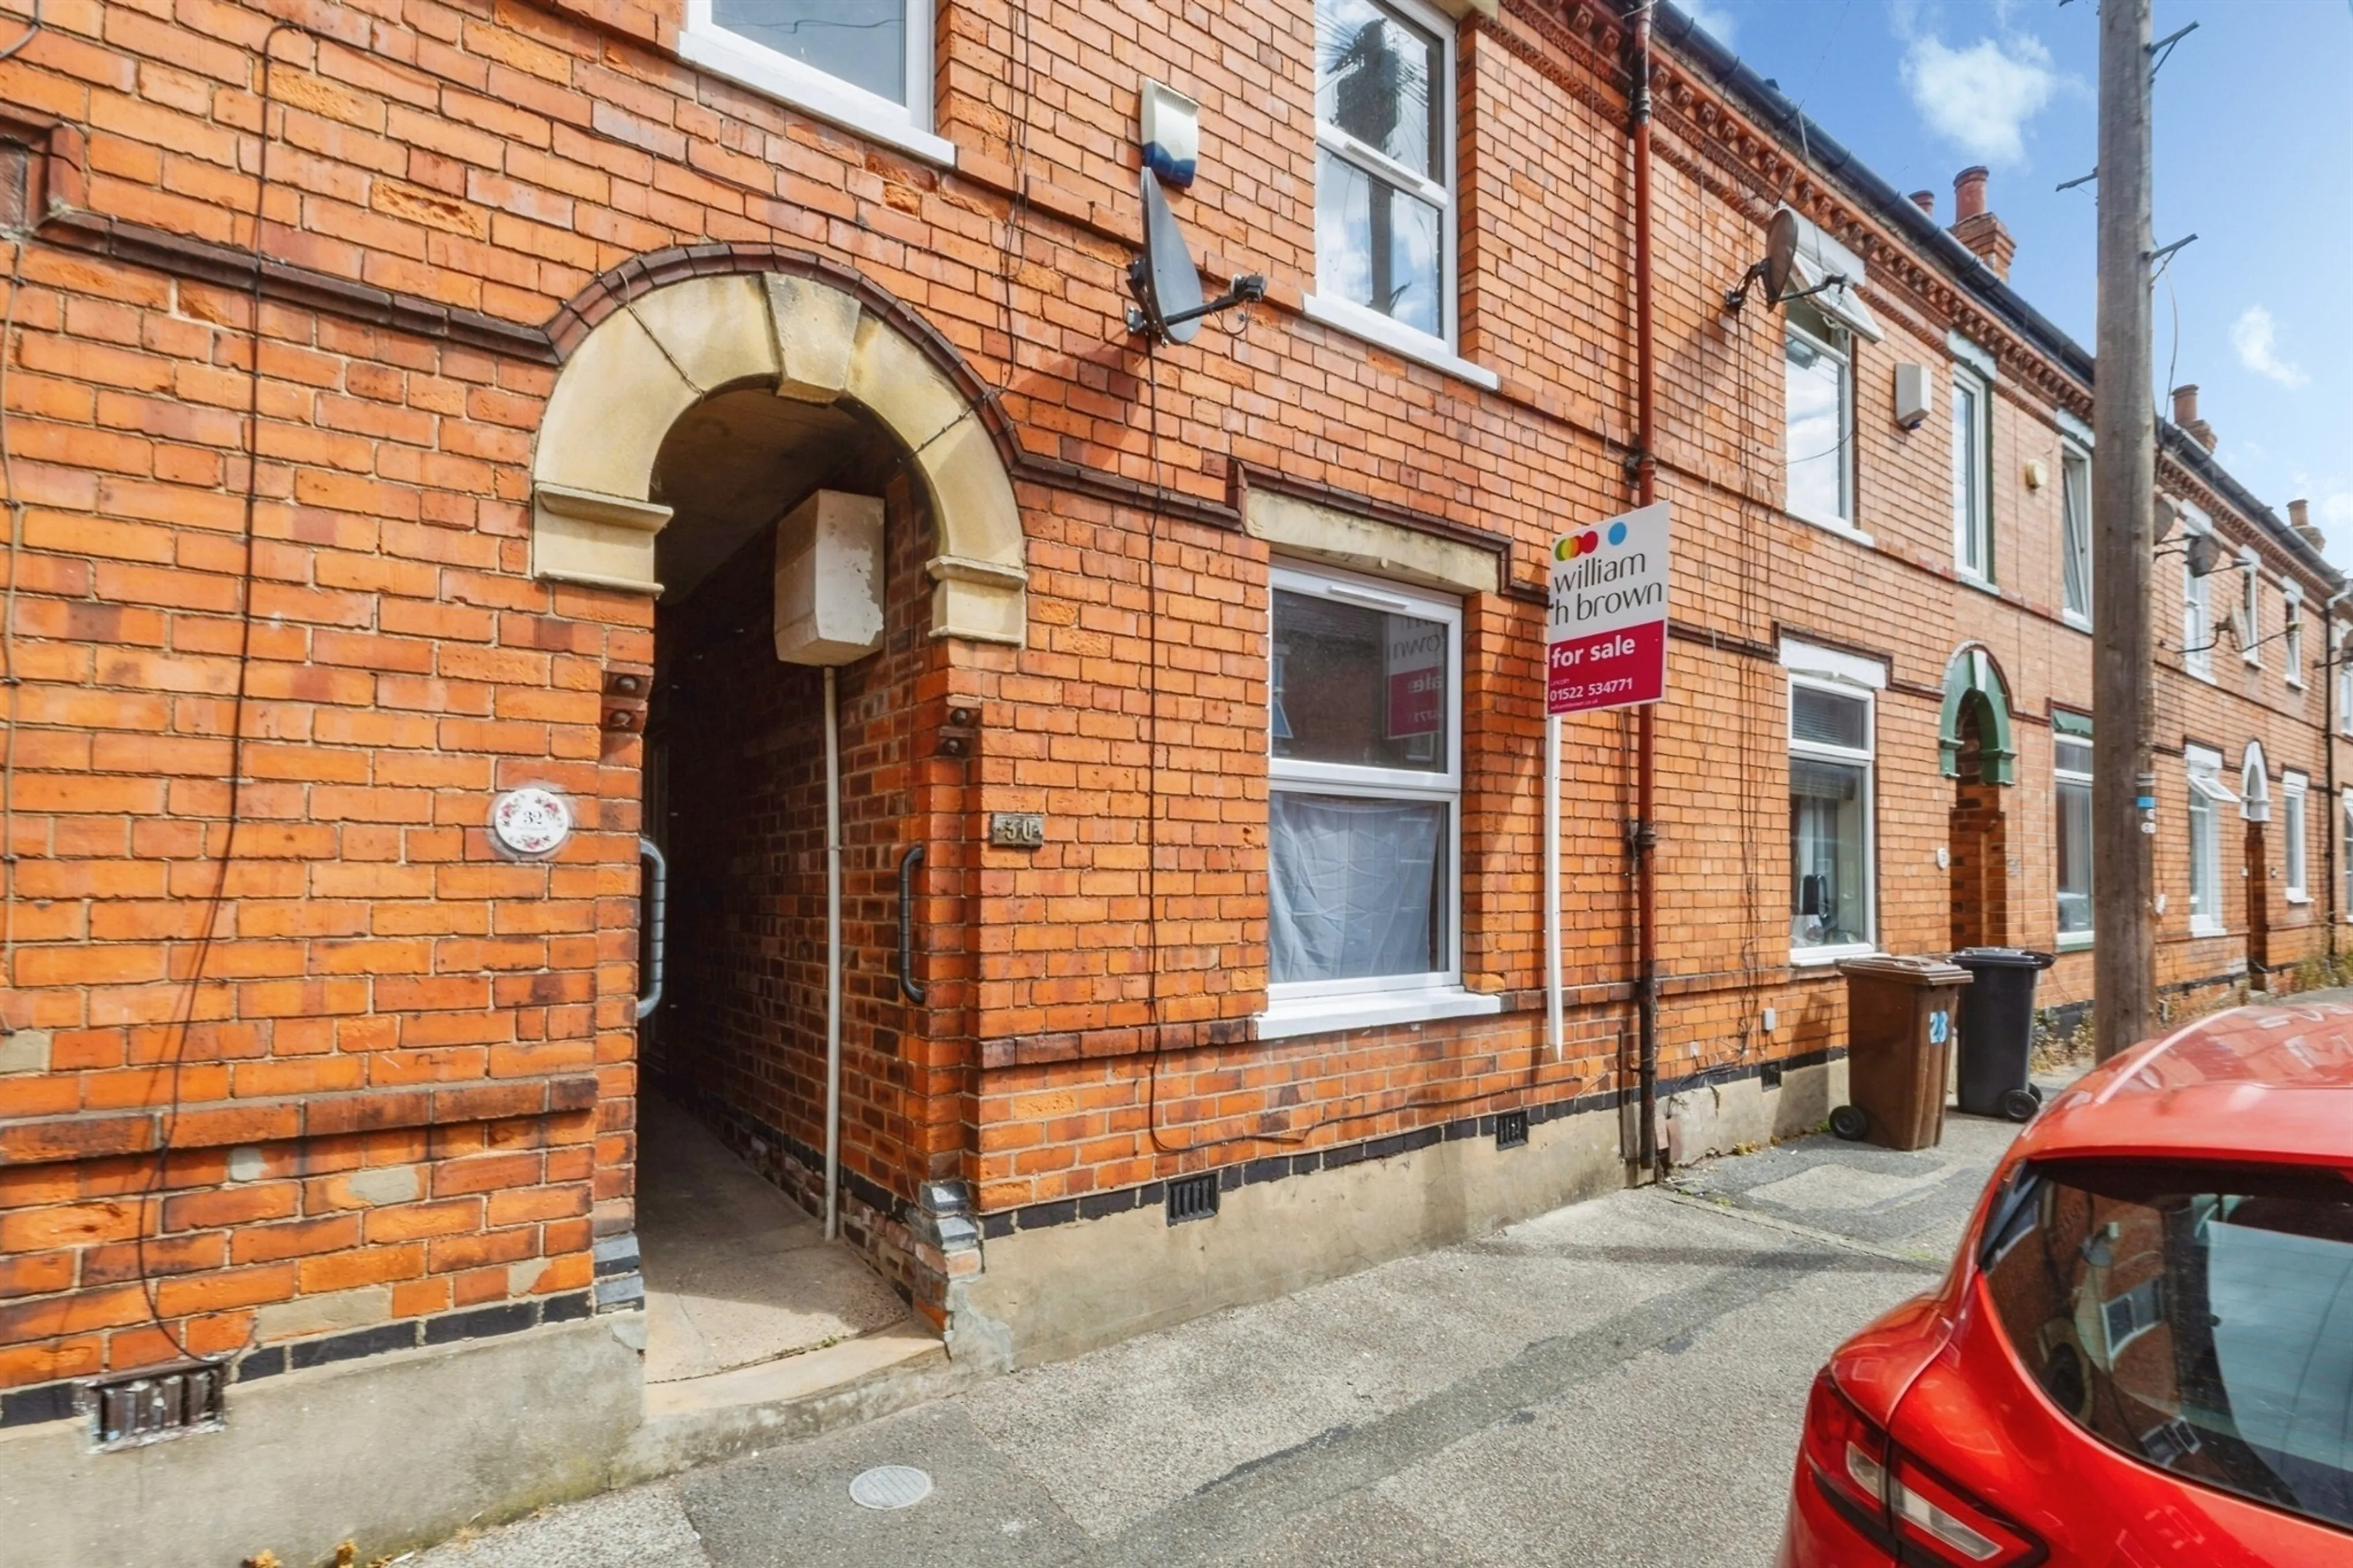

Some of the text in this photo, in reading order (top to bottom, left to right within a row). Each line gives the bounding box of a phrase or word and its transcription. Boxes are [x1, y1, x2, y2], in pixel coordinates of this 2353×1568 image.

[1554, 553, 1645, 594] william
[1555, 582, 1662, 625] h brown
[1552, 635, 1635, 668] for sale
[1550, 677, 1632, 702] 01522 534771
[523, 811, 542, 825] 32
